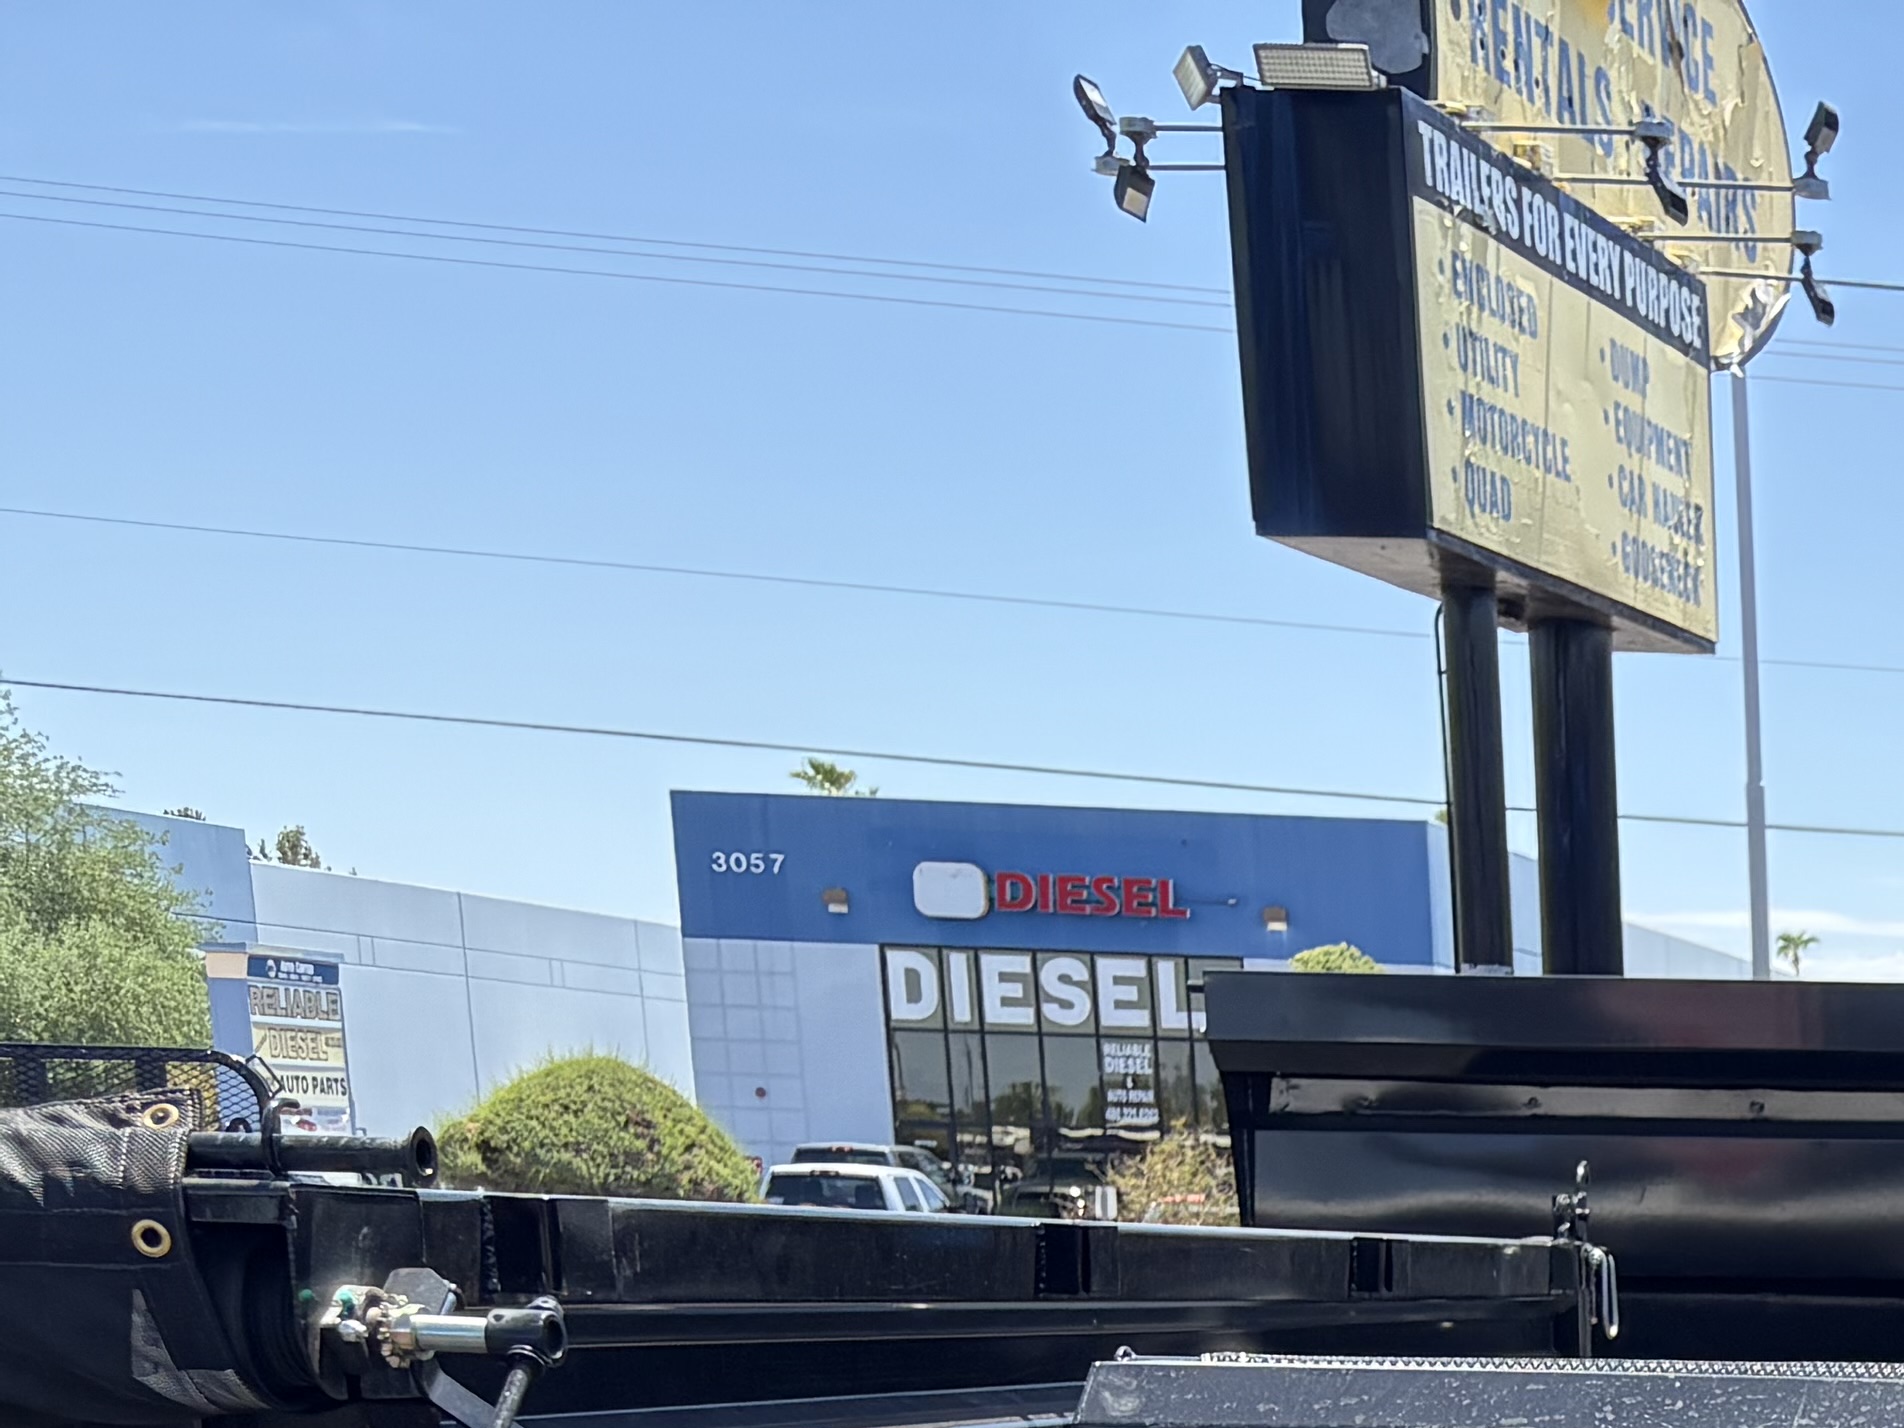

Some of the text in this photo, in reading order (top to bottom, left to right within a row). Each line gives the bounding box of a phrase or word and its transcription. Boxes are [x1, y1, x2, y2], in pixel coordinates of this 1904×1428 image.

[1417, 120, 1702, 350] TRAILERS FOR EVERY PURPOSE
[1456, 327, 1520, 399] UTILITY
[1460, 391, 1572, 483] MOTORCYCLE
[1614, 401, 1692, 481] EQUIPMENT
[1464, 459, 1513, 523] QUAD
[1618, 464, 1648, 519] CAR
[711, 851, 785, 875] 3057
[994, 871, 1191, 920] DIESEL
[249, 985, 341, 1022] RELIABLE
[889, 950, 1208, 1033] DIESEL
[268, 1026, 329, 1062] DIESEL
[1104, 1056, 1153, 1075] DIESEL
[280, 1075, 348, 1097] AUTO PARTS
